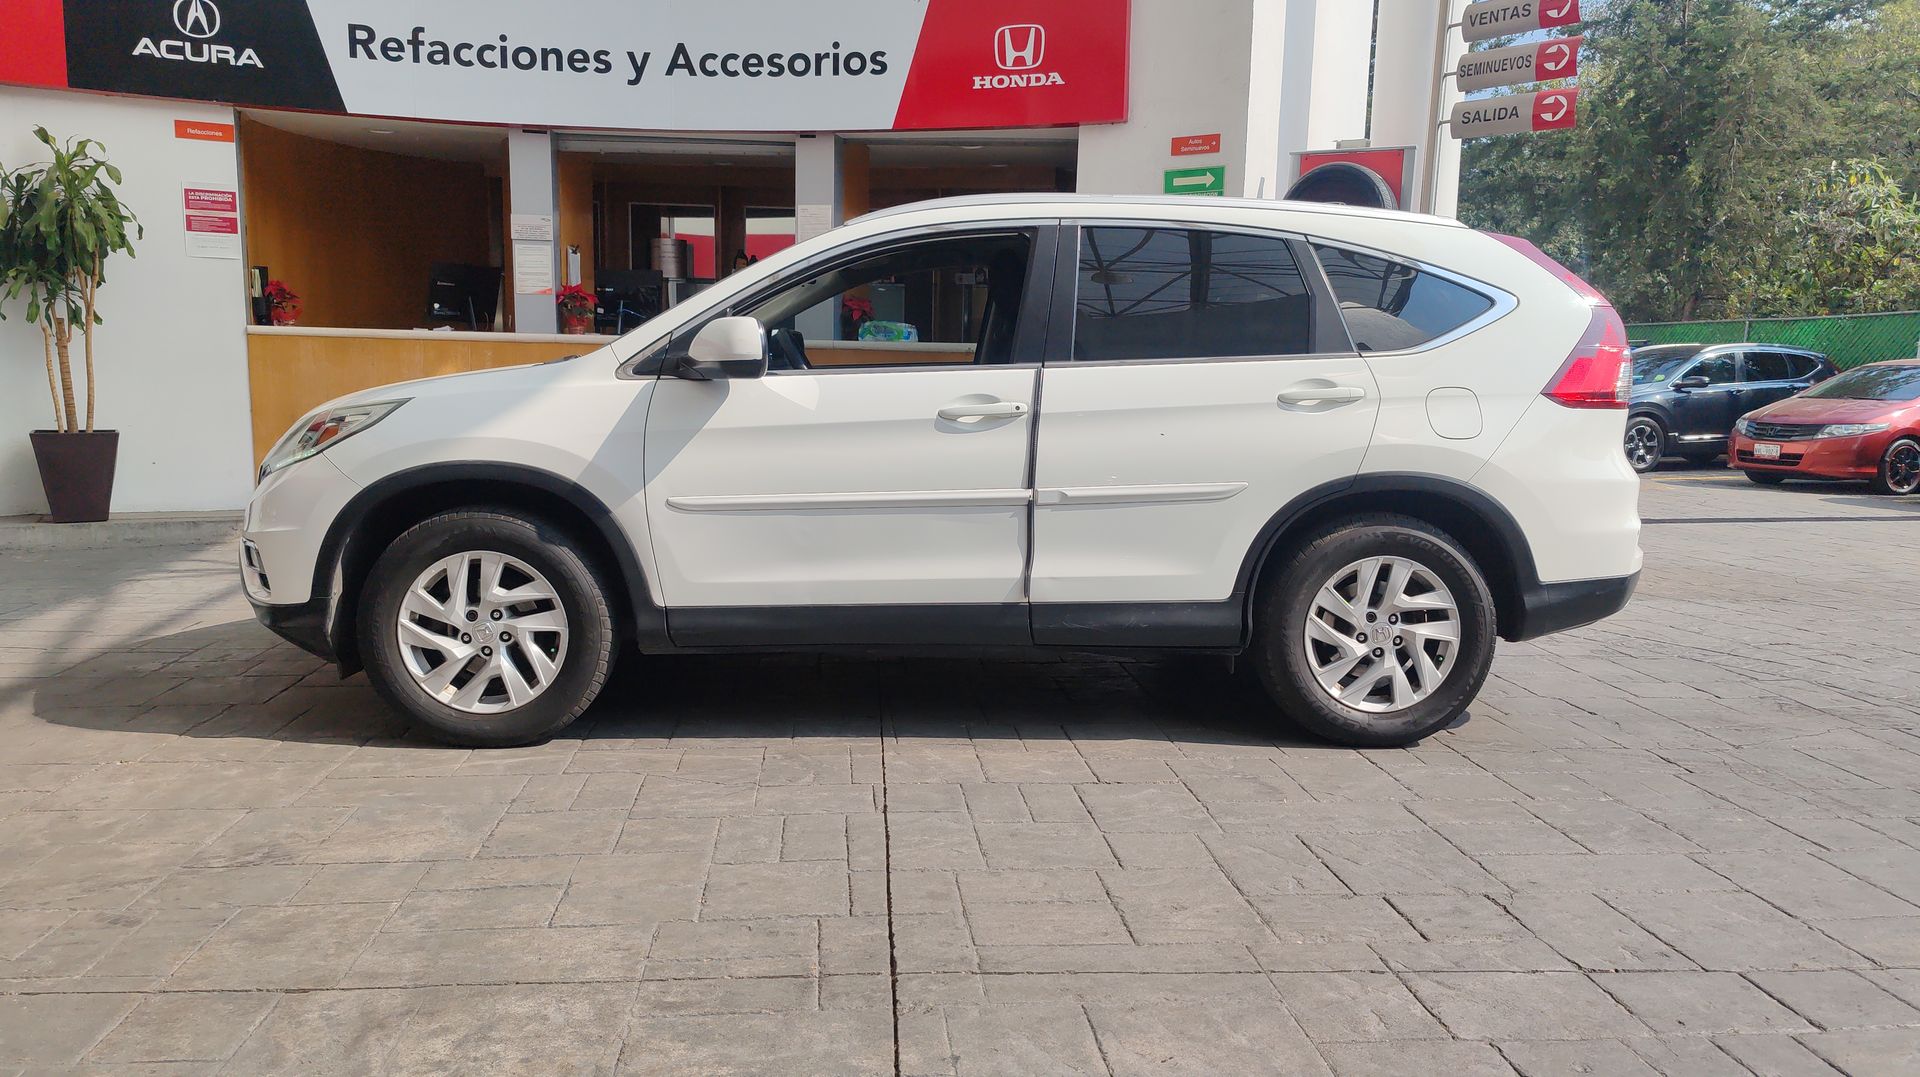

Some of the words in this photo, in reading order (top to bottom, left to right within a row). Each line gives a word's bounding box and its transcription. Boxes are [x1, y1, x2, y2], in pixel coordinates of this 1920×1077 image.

[1469, 3, 1532, 28] VENTAS
[131, 37, 264, 69] ACURA
[347, 23, 613, 74] Refacciones
[626, 51, 651, 86] y
[664, 41, 888, 79] Accesorios
[1459, 54, 1532, 78] SEMINUEVOS
[972, 71, 1066, 90] HONDA
[1461, 105, 1520, 125] SALIDA
[186, 127, 223, 137] Refacciones
